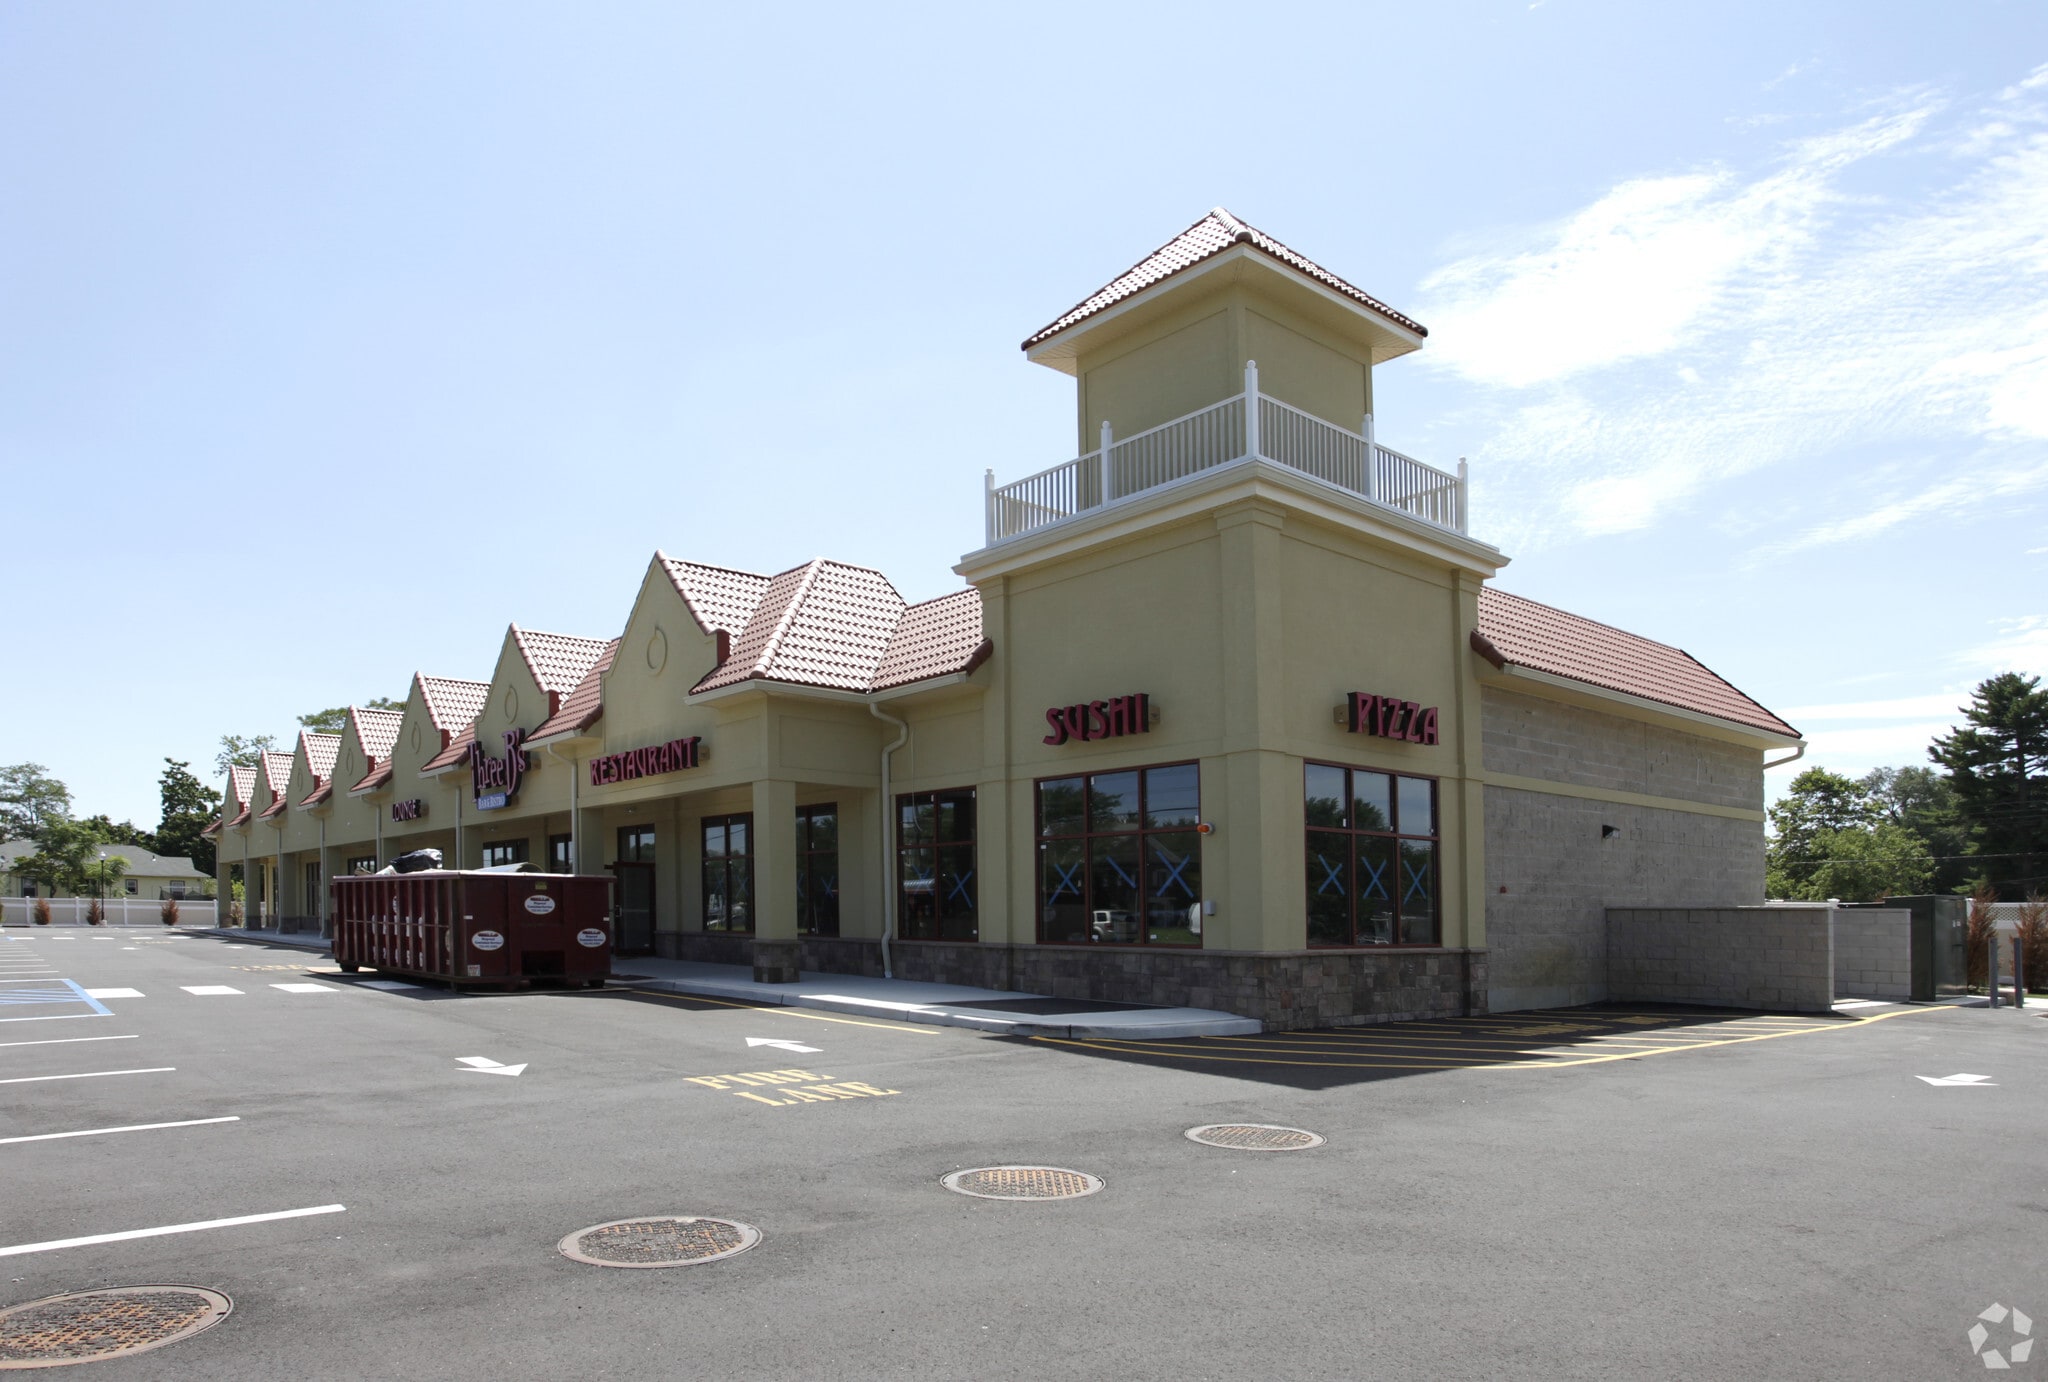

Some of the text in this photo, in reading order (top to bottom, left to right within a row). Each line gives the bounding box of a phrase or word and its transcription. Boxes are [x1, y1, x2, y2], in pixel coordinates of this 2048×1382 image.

[1042, 692, 1149, 746] SUSHI
[1347, 691, 1440, 746] PIZZA
[467, 727, 529, 803] Three B's
[590, 736, 701, 786] RESTAURANT
[392, 799, 419, 822] LOUNGE
[682, 1068, 836, 1090] FIRE
[733, 1081, 902, 1107] LANE
